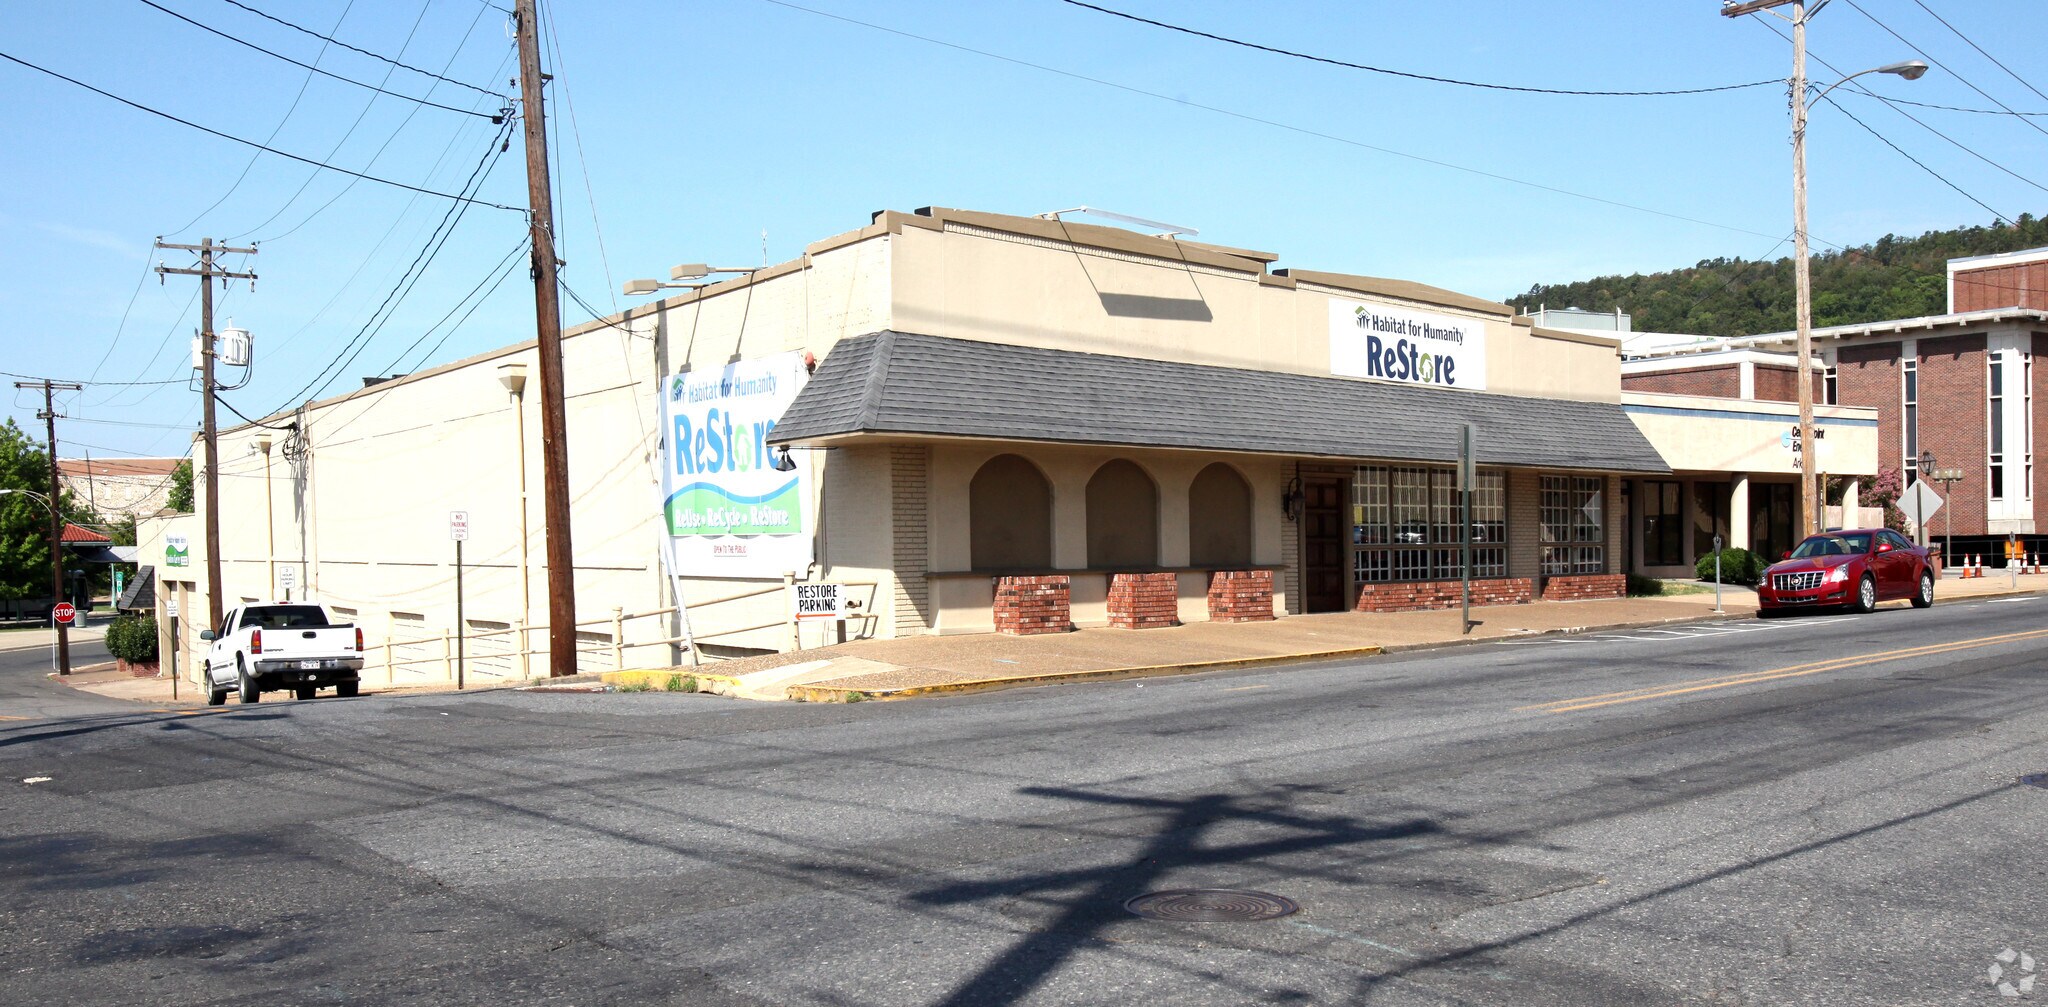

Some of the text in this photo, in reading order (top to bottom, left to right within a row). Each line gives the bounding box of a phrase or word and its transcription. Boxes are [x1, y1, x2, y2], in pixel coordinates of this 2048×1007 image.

[1372, 314, 1464, 346] Habitat for Humanity
[1366, 335, 1455, 385] ReStore
[689, 371, 778, 404] Habitat for Humanity
[675, 504, 789, 532] ReUse ReCycle ReStore
[713, 545, 723, 554] OPEN
[727, 545, 735, 553] THE
[735, 545, 747, 553] PUBLIC
[797, 585, 837, 599] RESTORE
[55, 608, 74, 617] STOP
[799, 598, 836, 612] PARKING
